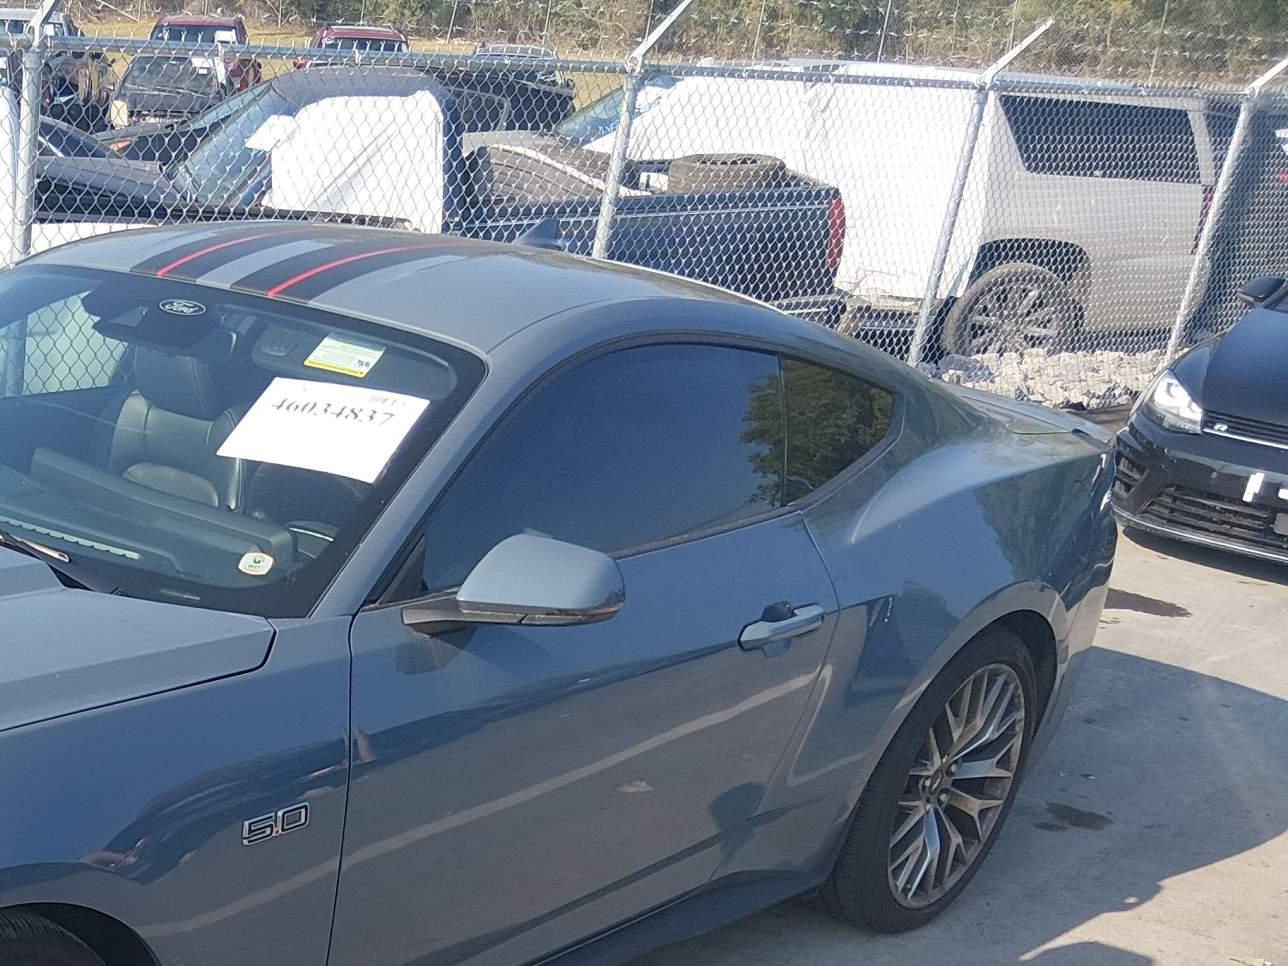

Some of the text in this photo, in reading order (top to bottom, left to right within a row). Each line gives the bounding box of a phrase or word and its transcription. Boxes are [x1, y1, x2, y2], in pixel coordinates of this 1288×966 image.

[164, 301, 199, 313] Ford
[271, 397, 396, 426] 46034837
[242, 801, 310, 846] 5.0
